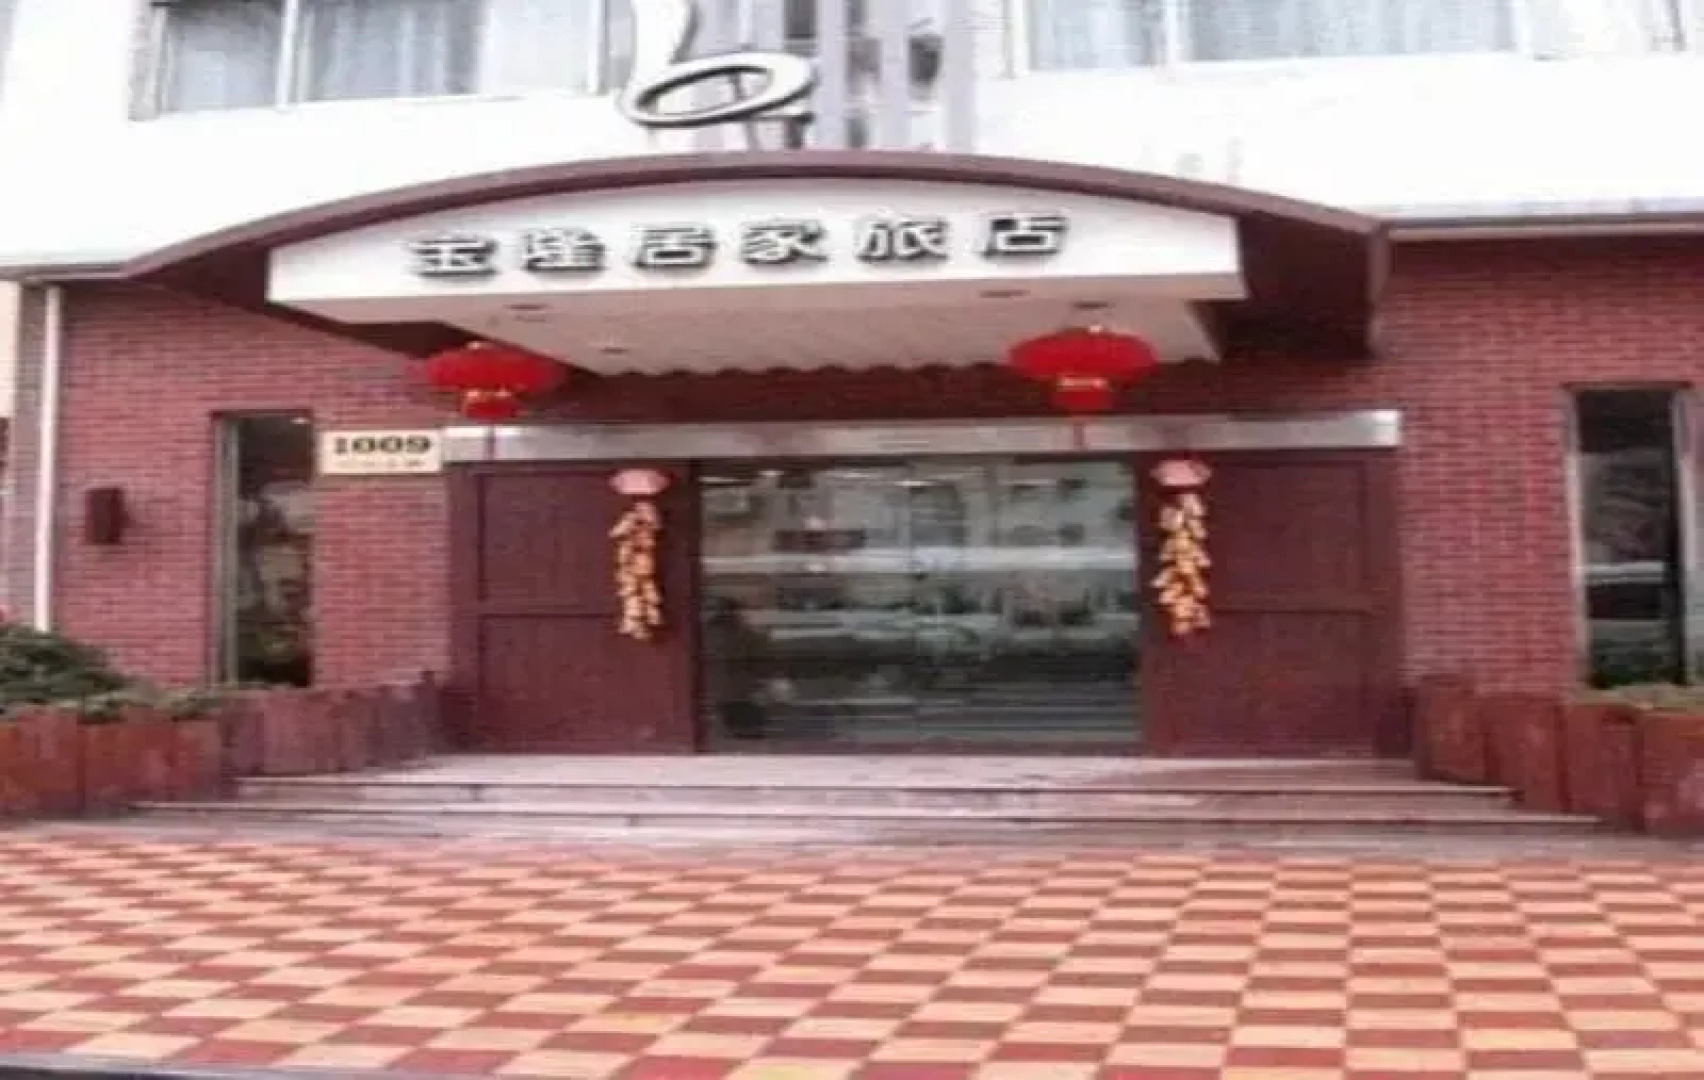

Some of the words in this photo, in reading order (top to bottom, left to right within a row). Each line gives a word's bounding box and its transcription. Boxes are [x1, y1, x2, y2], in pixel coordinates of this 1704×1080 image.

[408, 210, 1068, 279] 宝隆居家旅店
[334, 436, 432, 455] 1009
